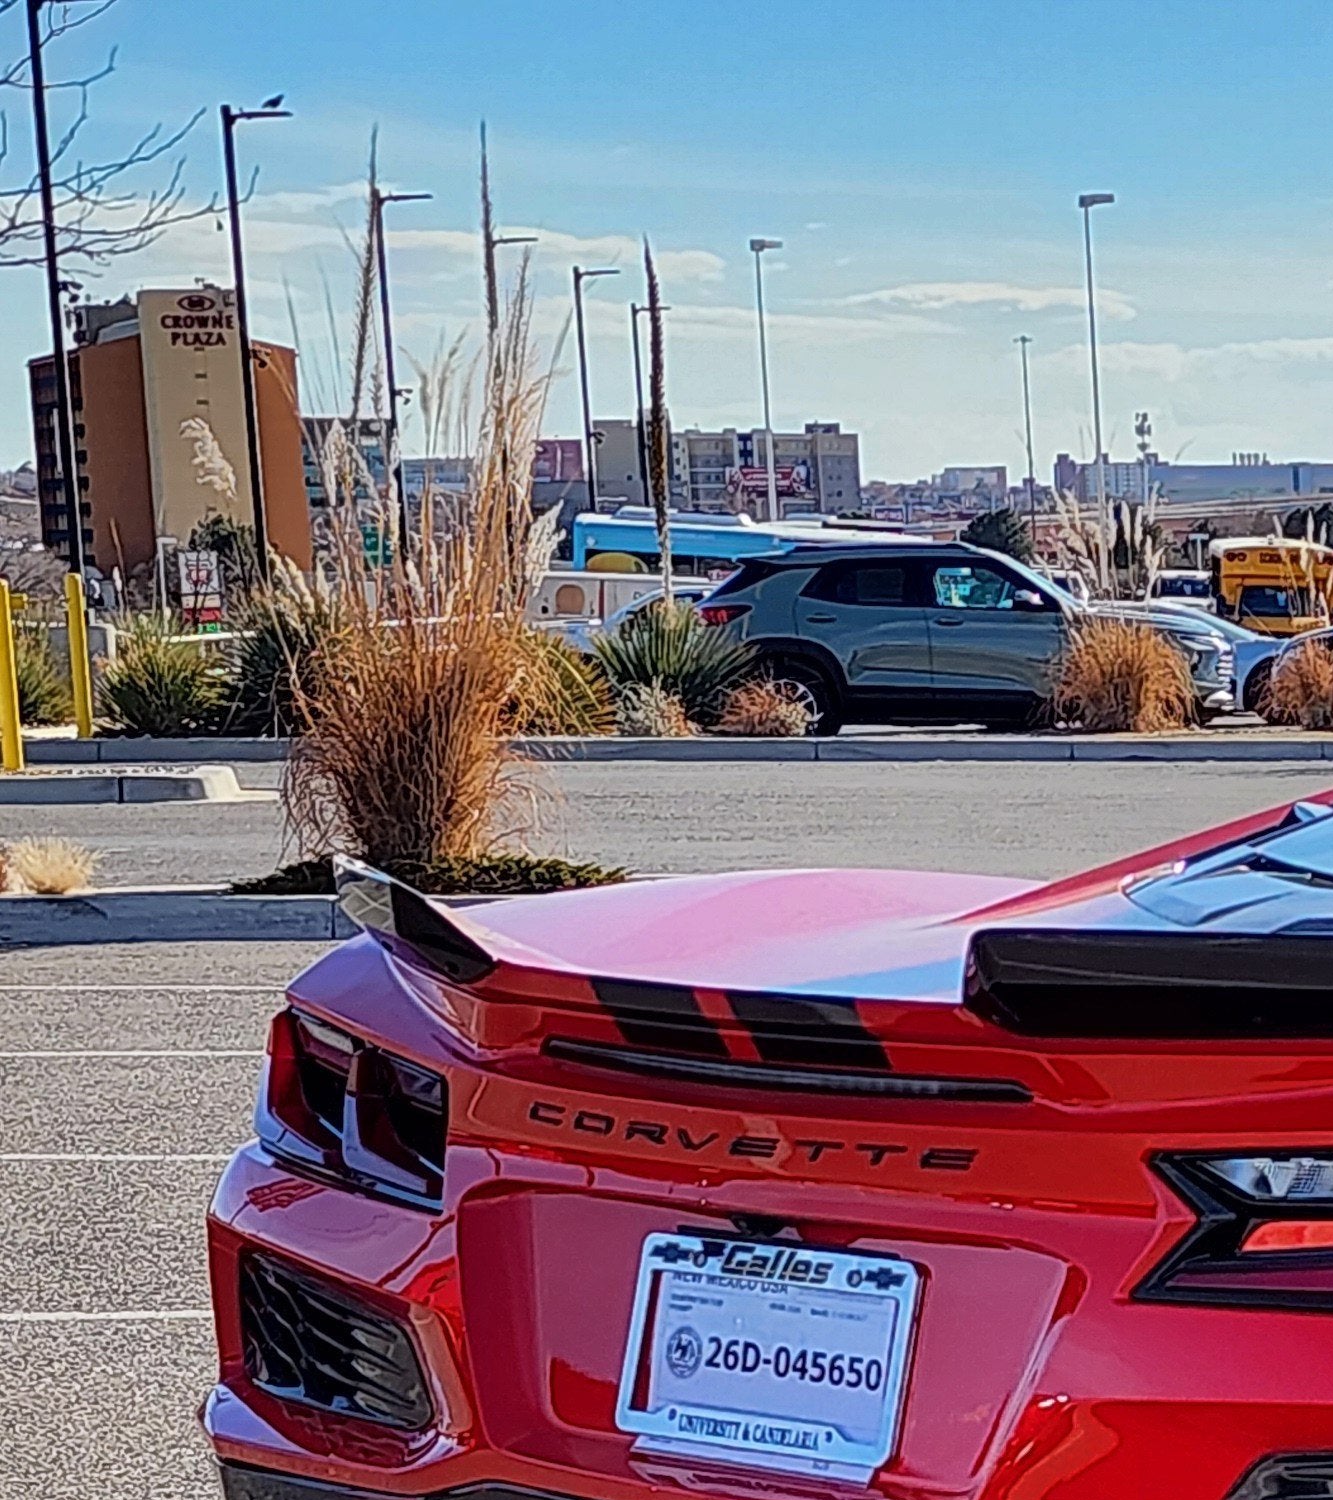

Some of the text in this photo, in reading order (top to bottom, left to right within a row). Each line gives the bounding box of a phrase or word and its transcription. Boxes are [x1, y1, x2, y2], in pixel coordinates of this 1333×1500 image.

[160, 314, 235, 329] CROWNE
[170, 331, 227, 346] PLAZA
[529, 1100, 979, 1171] CORVETTE
[720, 1244, 835, 1285] Galles
[704, 1335, 883, 1391] 26D-045650
[678, 1413, 742, 1441] UNIVERSITY
[752, 1424, 820, 1451] CANDELARIA
